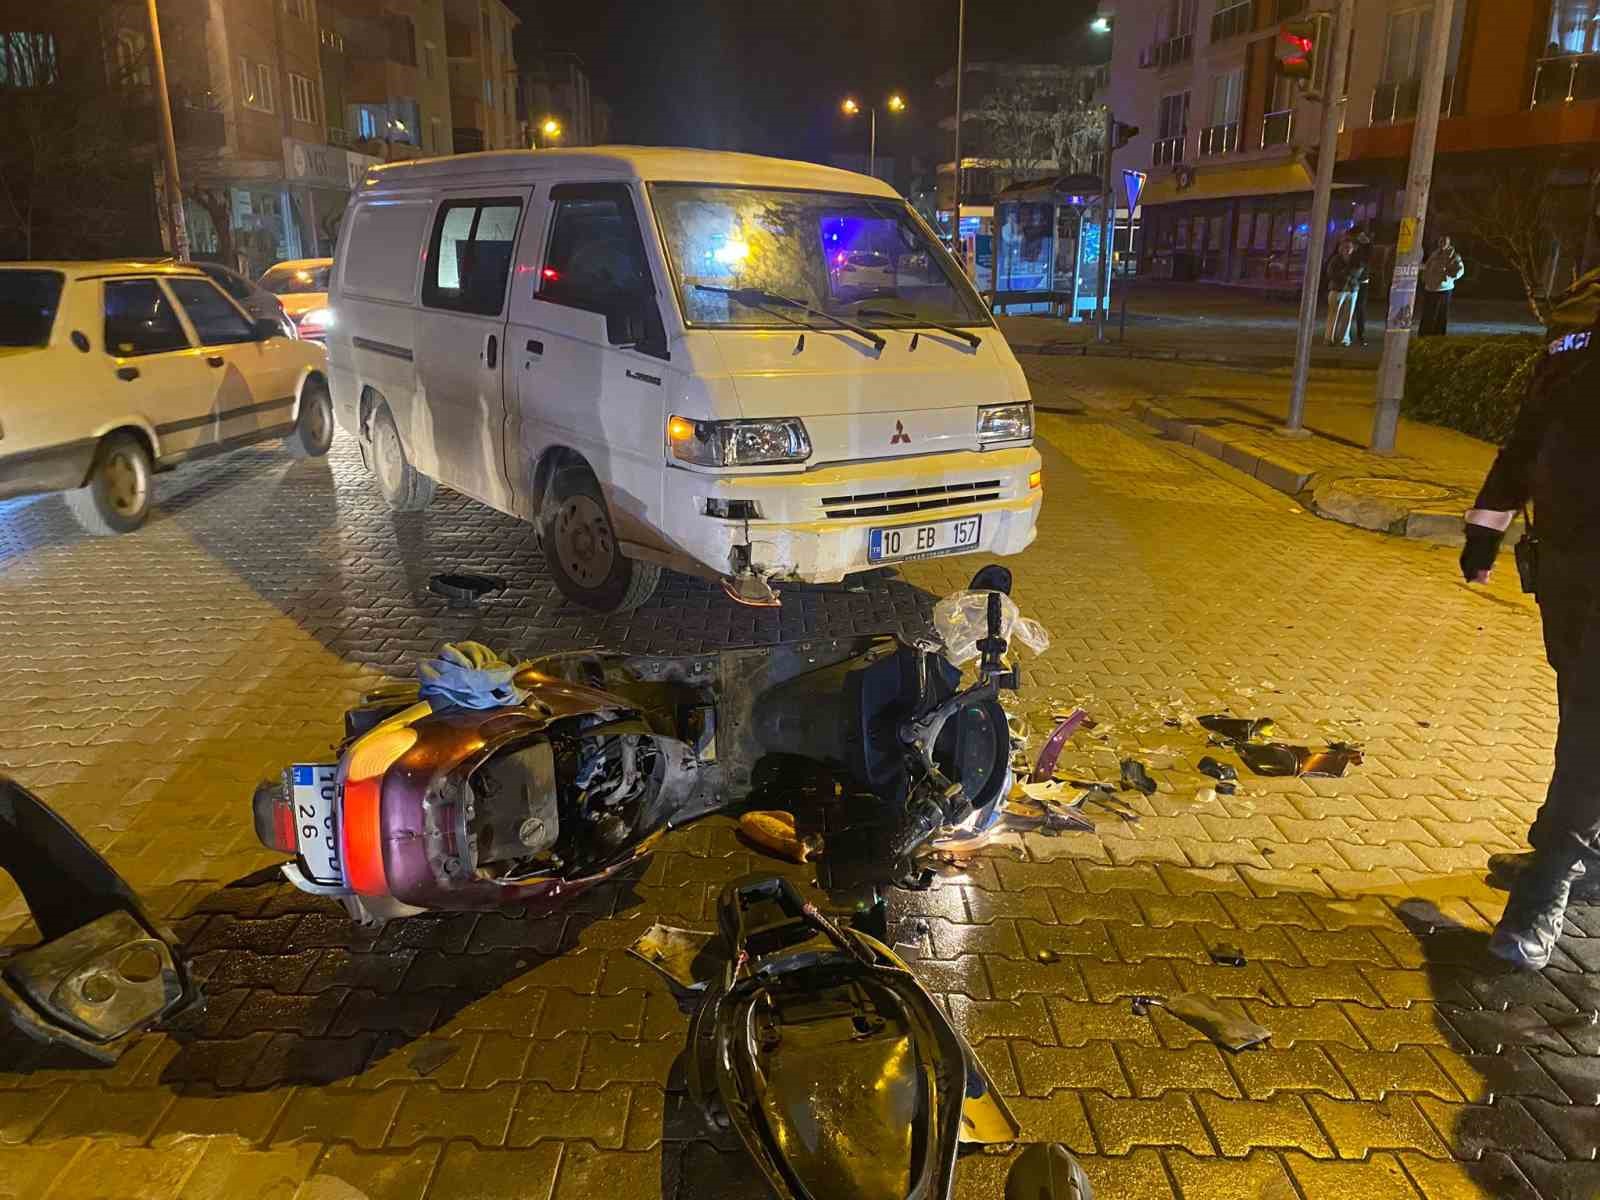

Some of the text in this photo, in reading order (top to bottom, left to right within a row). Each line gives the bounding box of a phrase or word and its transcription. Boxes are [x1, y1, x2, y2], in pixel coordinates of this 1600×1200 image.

[884, 531, 901, 555] 10
[917, 526, 936, 550] EB
[953, 520, 977, 545] 157
[320, 772, 337, 801] 10
[299, 804, 319, 839] 26
